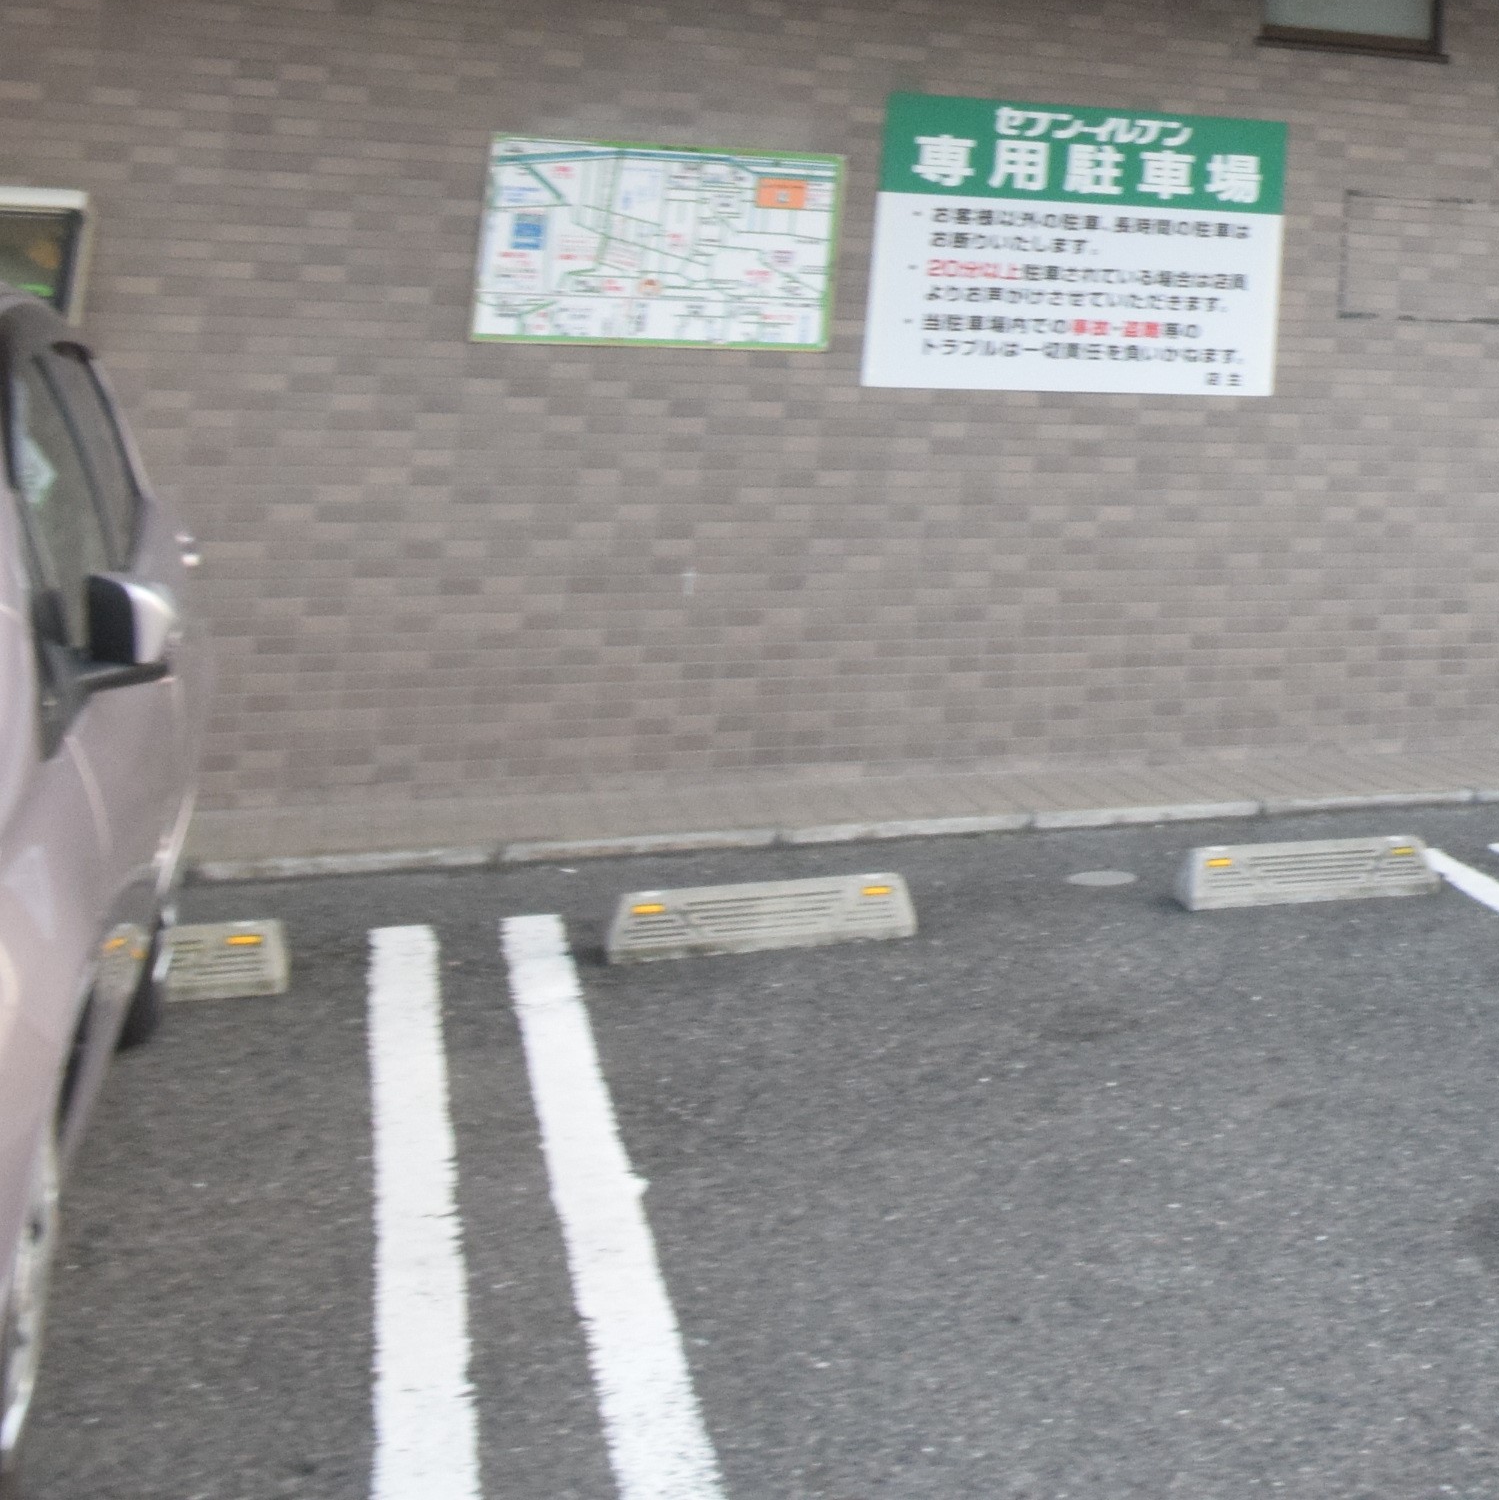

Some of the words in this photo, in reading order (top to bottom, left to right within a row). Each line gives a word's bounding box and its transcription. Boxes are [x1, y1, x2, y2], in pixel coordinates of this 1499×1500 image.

[911, 134, 1263, 204] 専用駐車場
